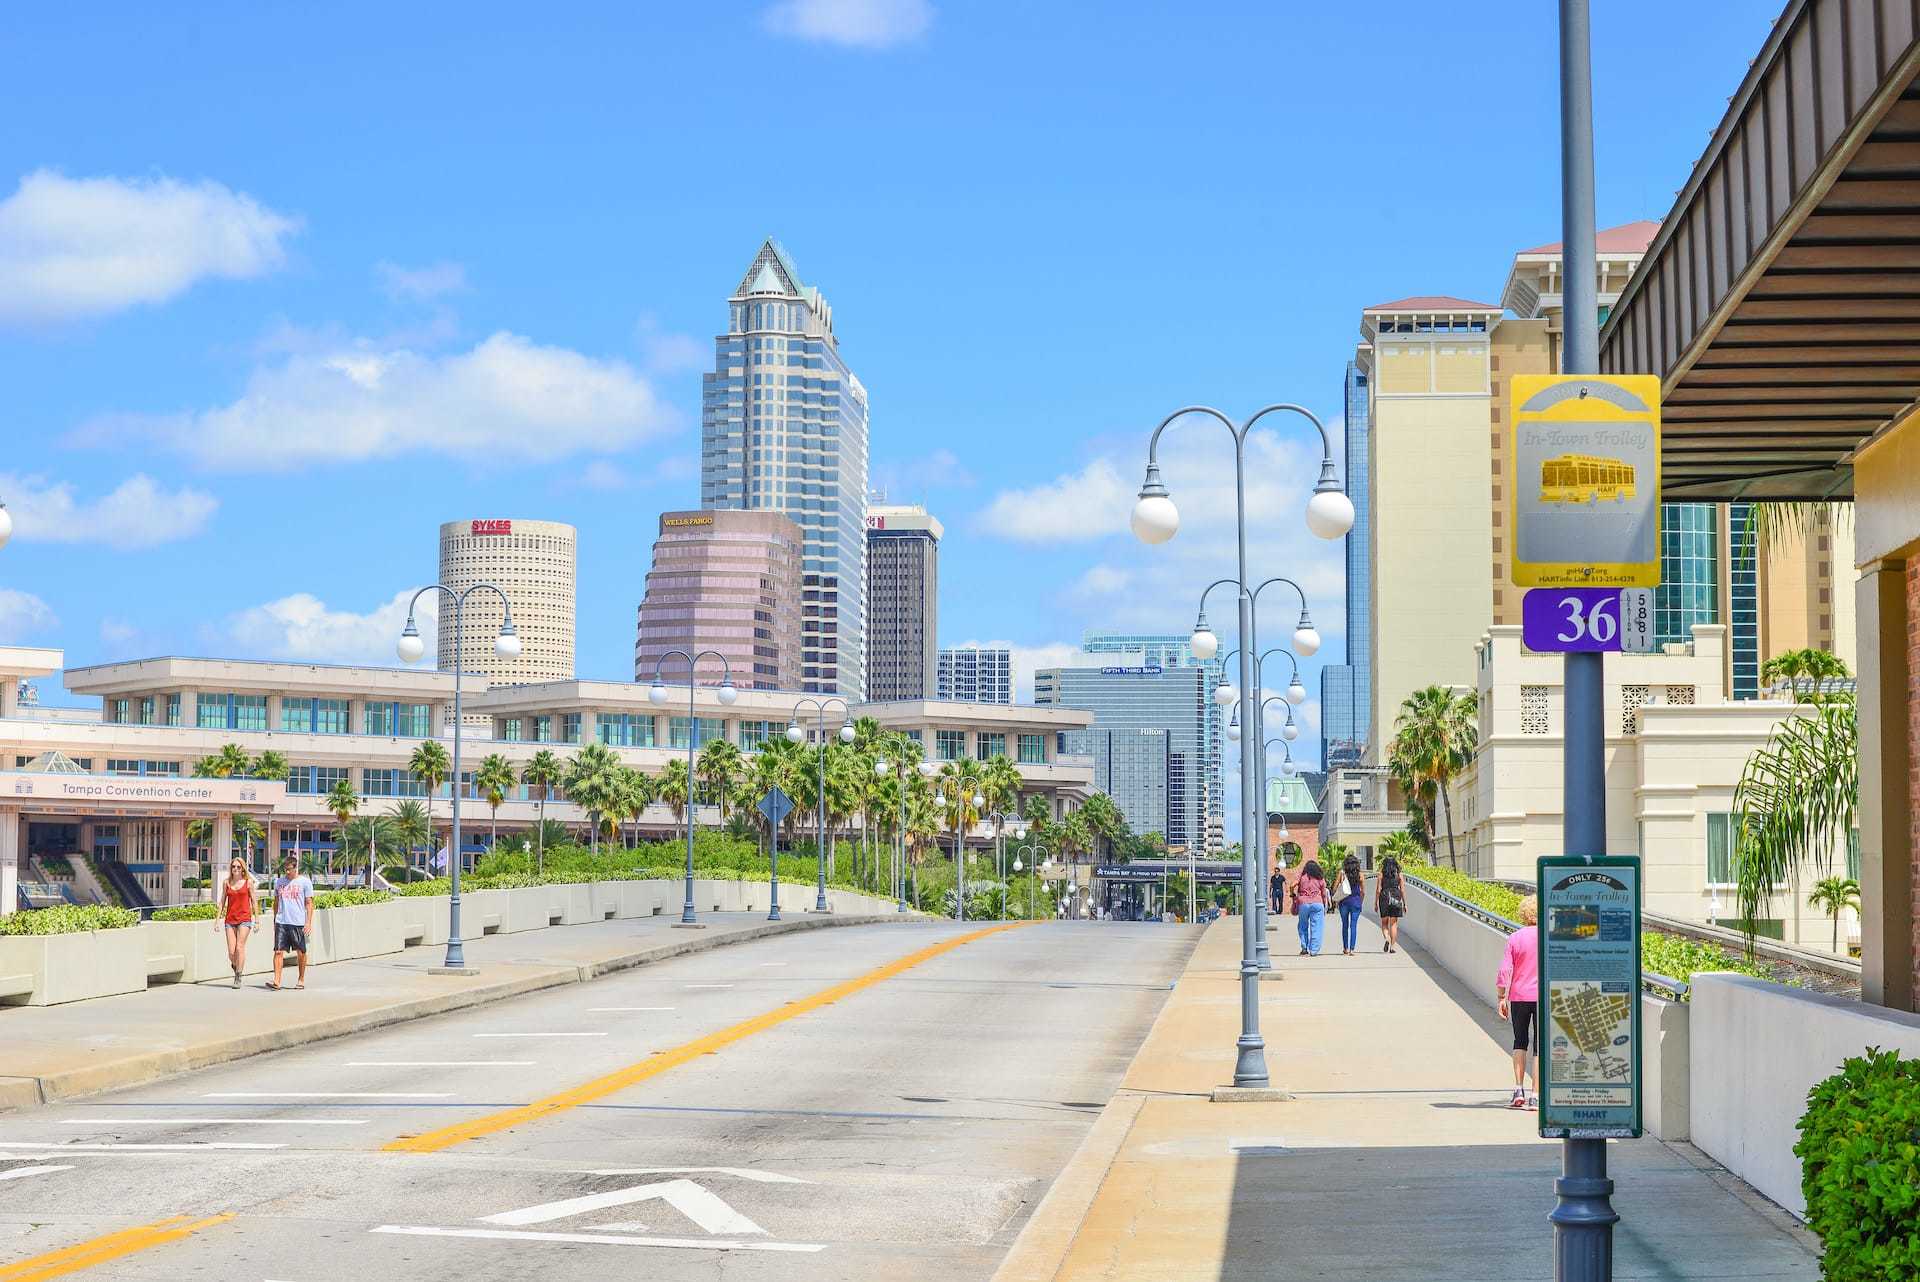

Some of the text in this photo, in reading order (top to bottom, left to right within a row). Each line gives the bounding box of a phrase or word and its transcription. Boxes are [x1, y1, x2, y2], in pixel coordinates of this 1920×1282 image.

[1523, 430, 1648, 450] In-Town Trolley
[472, 519, 511, 530] SYKES
[690, 516, 713, 525] FARGO
[1566, 567, 1607, 576] goHAT.org
[1557, 596, 1616, 643] 36
[1637, 594, 1647, 648] 5881
[1140, 727, 1164, 736] Hilton
[63, 783, 212, 798] Tampa Convention Center
[1568, 873, 1592, 884] ONLY
[1594, 891, 1629, 904] Trolley
[1582, 1110, 1608, 1119] HART
